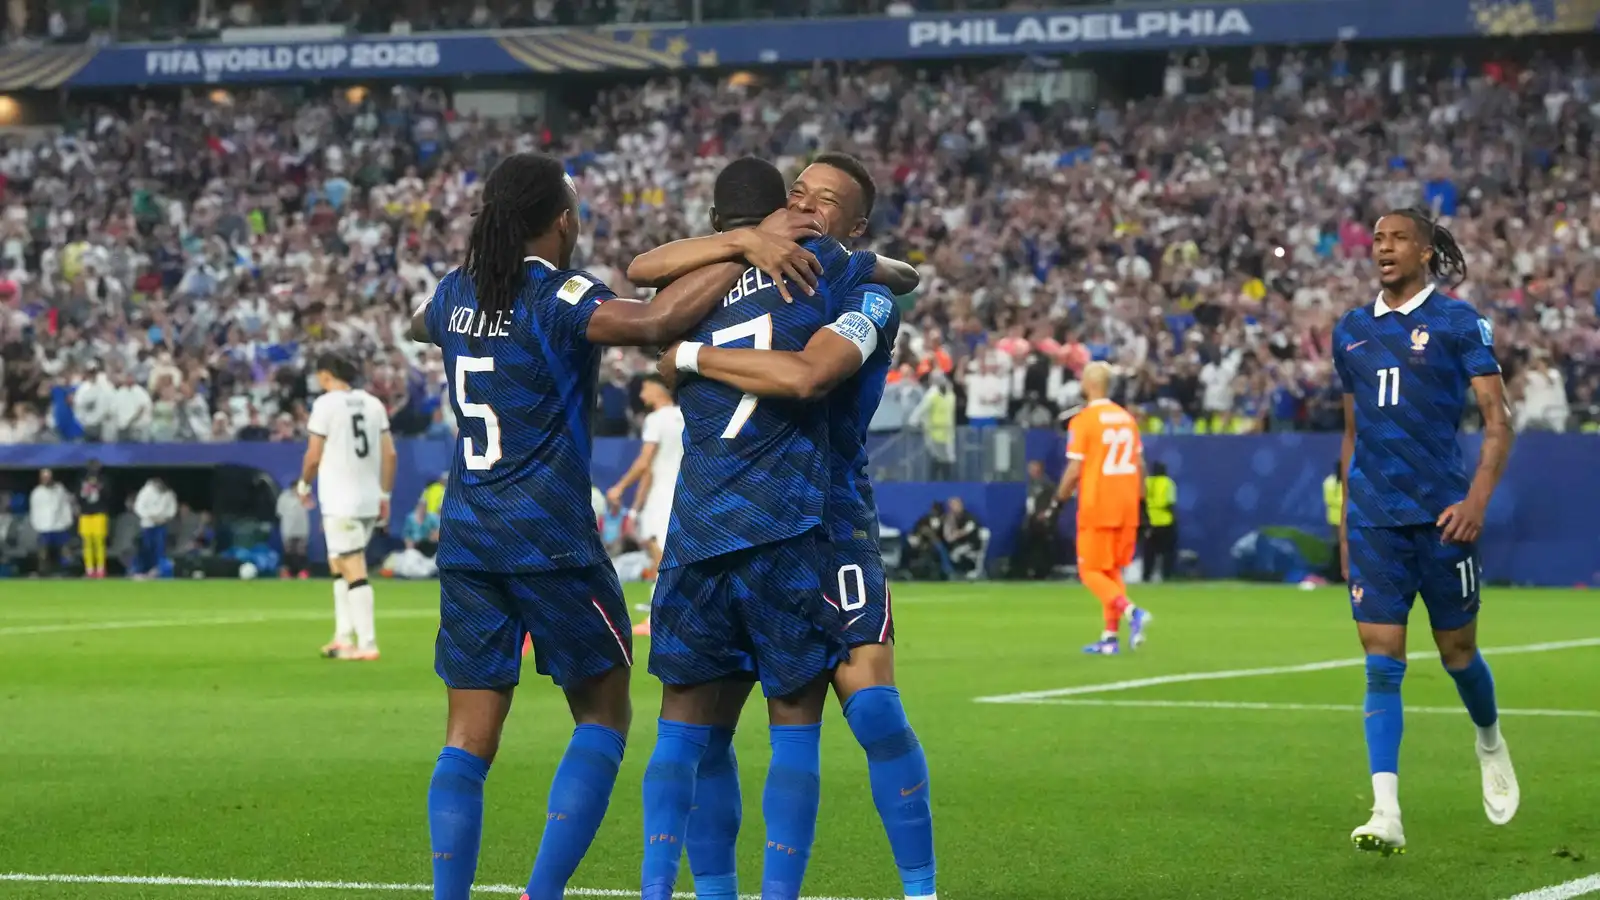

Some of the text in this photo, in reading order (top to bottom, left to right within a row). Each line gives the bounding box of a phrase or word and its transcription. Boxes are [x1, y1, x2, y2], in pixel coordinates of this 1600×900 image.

[909, 9, 1252, 47] PHILADELPHIA
[146, 41, 440, 75] FIFA WORLD CUP 2026
[841, 317, 869, 338] UNITES
[846, 312, 872, 332] FOOTBALL
[712, 312, 773, 439] 7
[1376, 367, 1400, 407] 11
[455, 355, 502, 471] 5
[351, 413, 369, 459] 5
[1102, 428, 1137, 476] 22
[1456, 556, 1475, 598] 11
